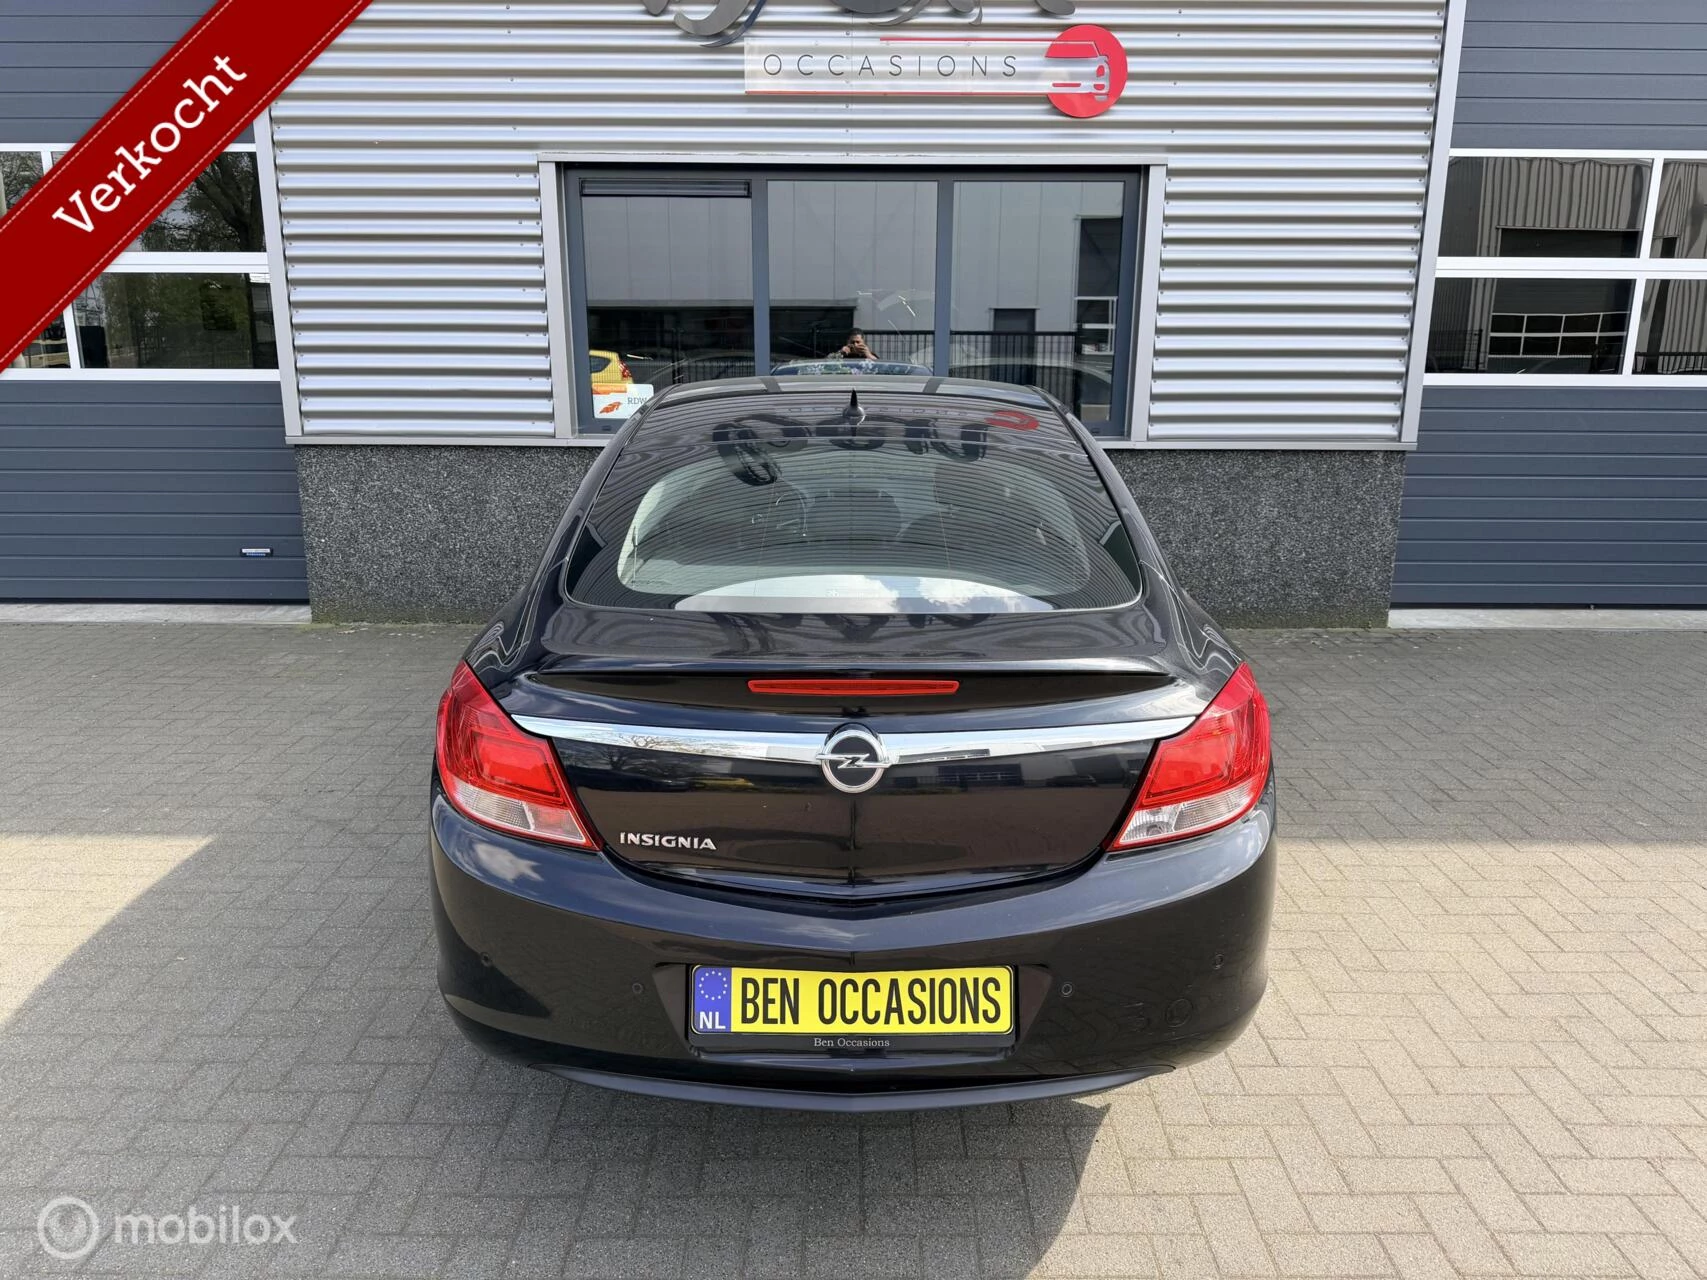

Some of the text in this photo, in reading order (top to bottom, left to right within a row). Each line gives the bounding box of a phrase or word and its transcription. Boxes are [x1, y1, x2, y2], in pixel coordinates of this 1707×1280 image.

[763, 53, 1017, 78] OCCASIONS
[620, 832, 717, 850] INSIGNIA
[740, 976, 1001, 1025] BEN OCCASIONS
[699, 1011, 726, 1029] NL
[813, 1037, 890, 1047] Ben Occasions
